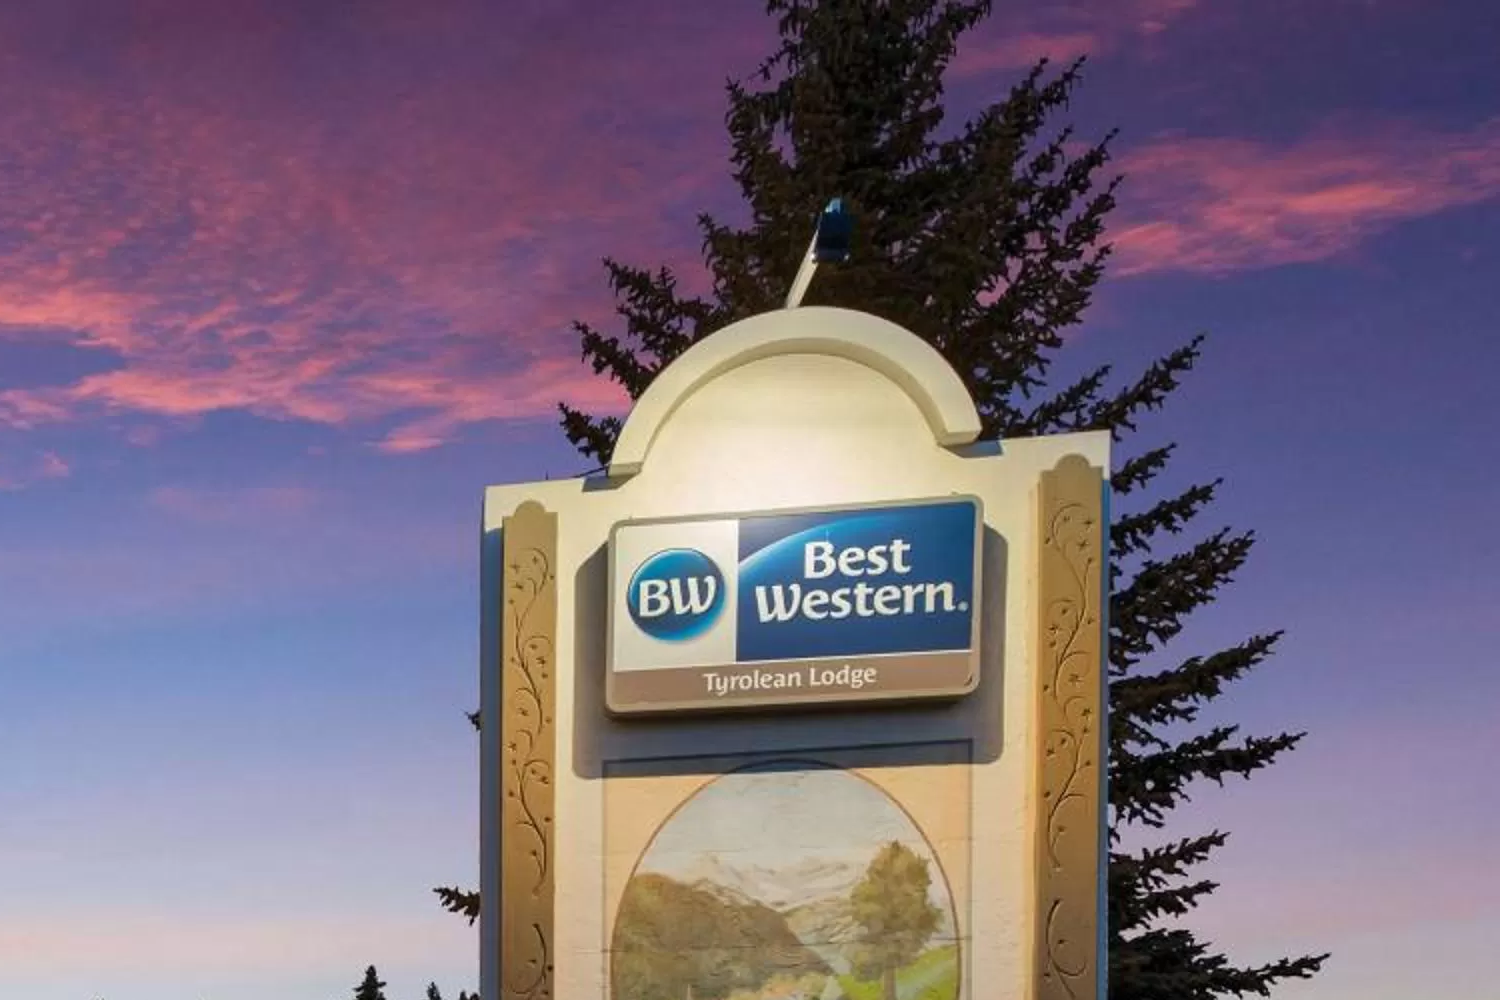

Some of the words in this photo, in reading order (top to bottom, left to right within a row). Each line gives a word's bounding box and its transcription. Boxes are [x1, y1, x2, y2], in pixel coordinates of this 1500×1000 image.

[803, 538, 912, 580] Best
[638, 573, 717, 618] BW
[702, 668, 802, 694] Tyrolean
[809, 664, 878, 690] Lodge
